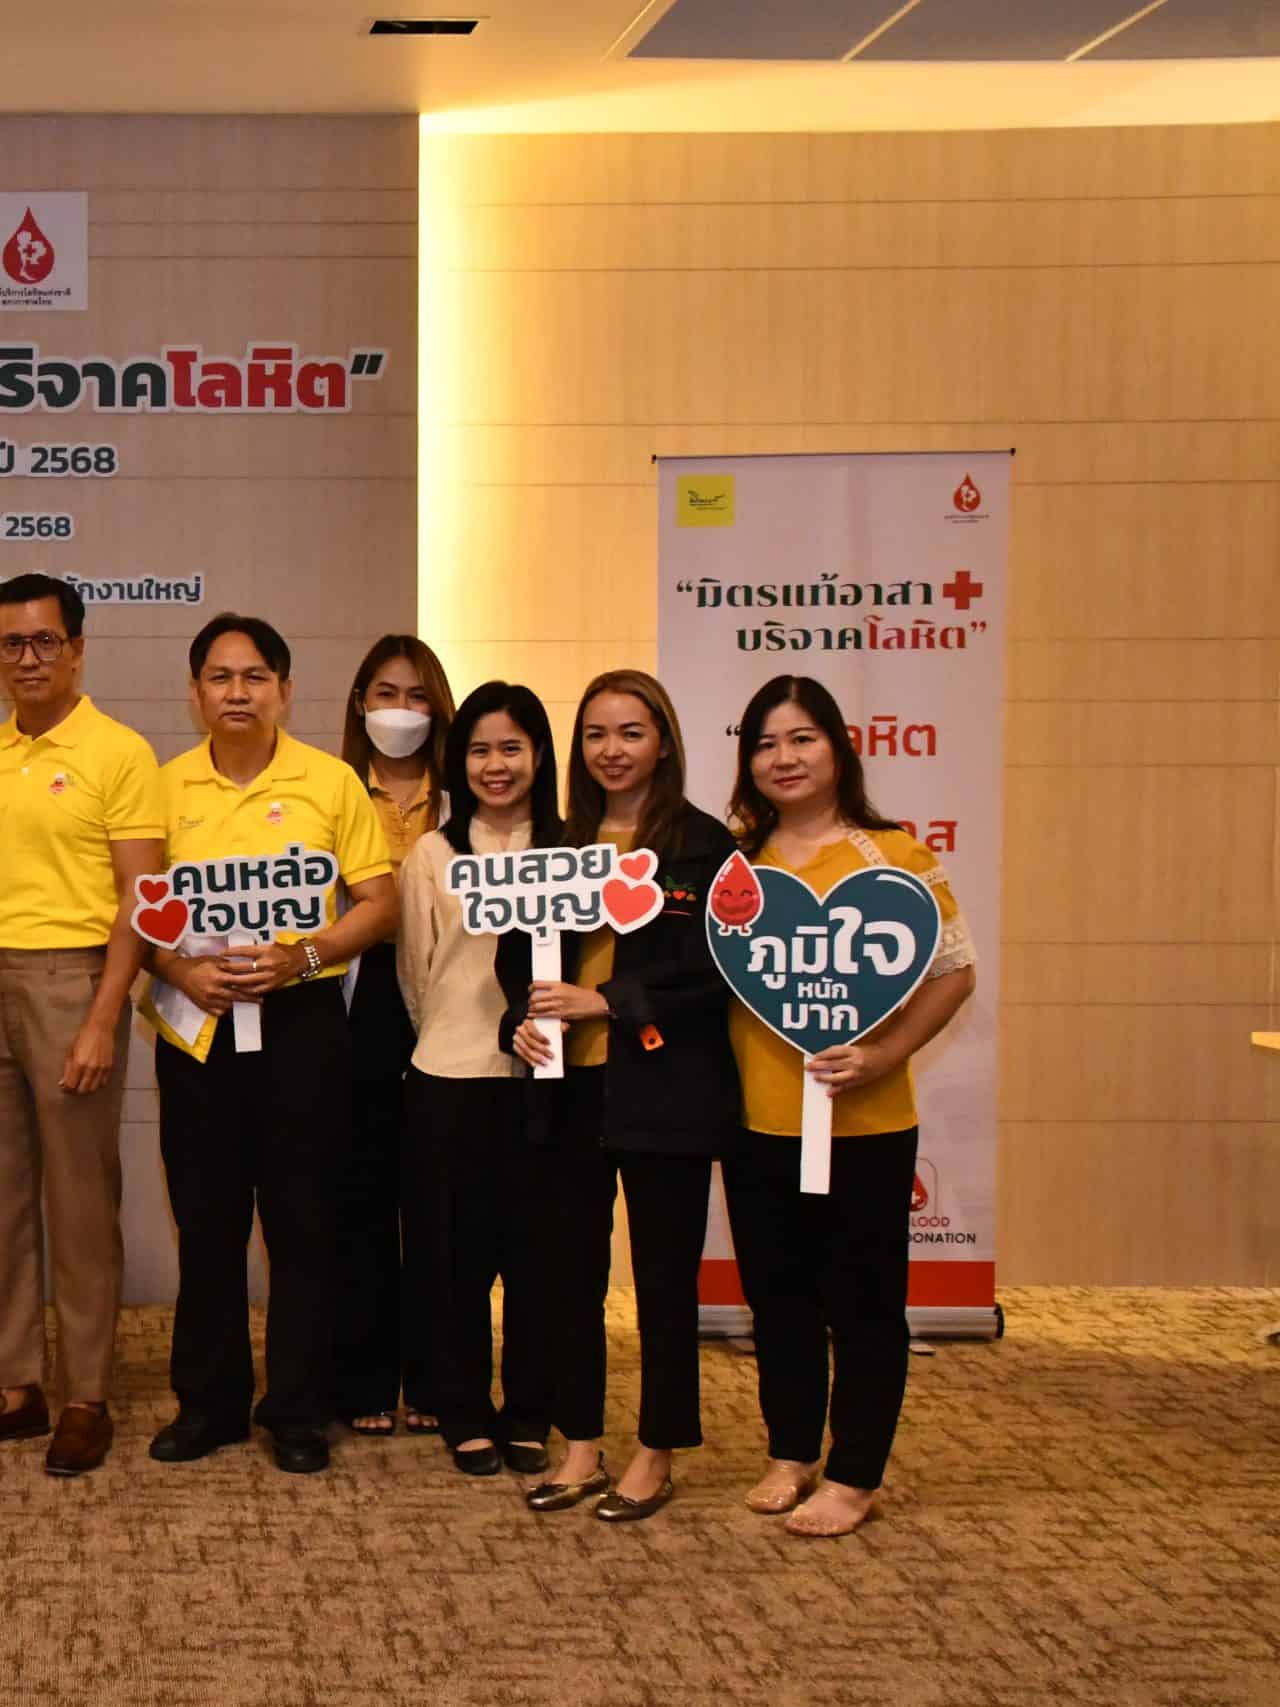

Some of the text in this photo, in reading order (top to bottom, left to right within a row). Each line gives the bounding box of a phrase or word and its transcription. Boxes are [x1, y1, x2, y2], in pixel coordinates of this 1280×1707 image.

[29, 446, 117, 474] 2568
[4, 516, 72, 537] 2568
[172, 846, 334, 896] คนหล่อ
[450, 847, 612, 890] คนสวย
[187, 896, 321, 942] ใจบุญ
[464, 889, 601, 938] ใจบุญ
[746, 905, 917, 990] ภูมิใจ
[797, 977, 849, 1000] หนัก
[781, 1002, 859, 1032] มาก
[911, 1216, 951, 1228] LOOD
